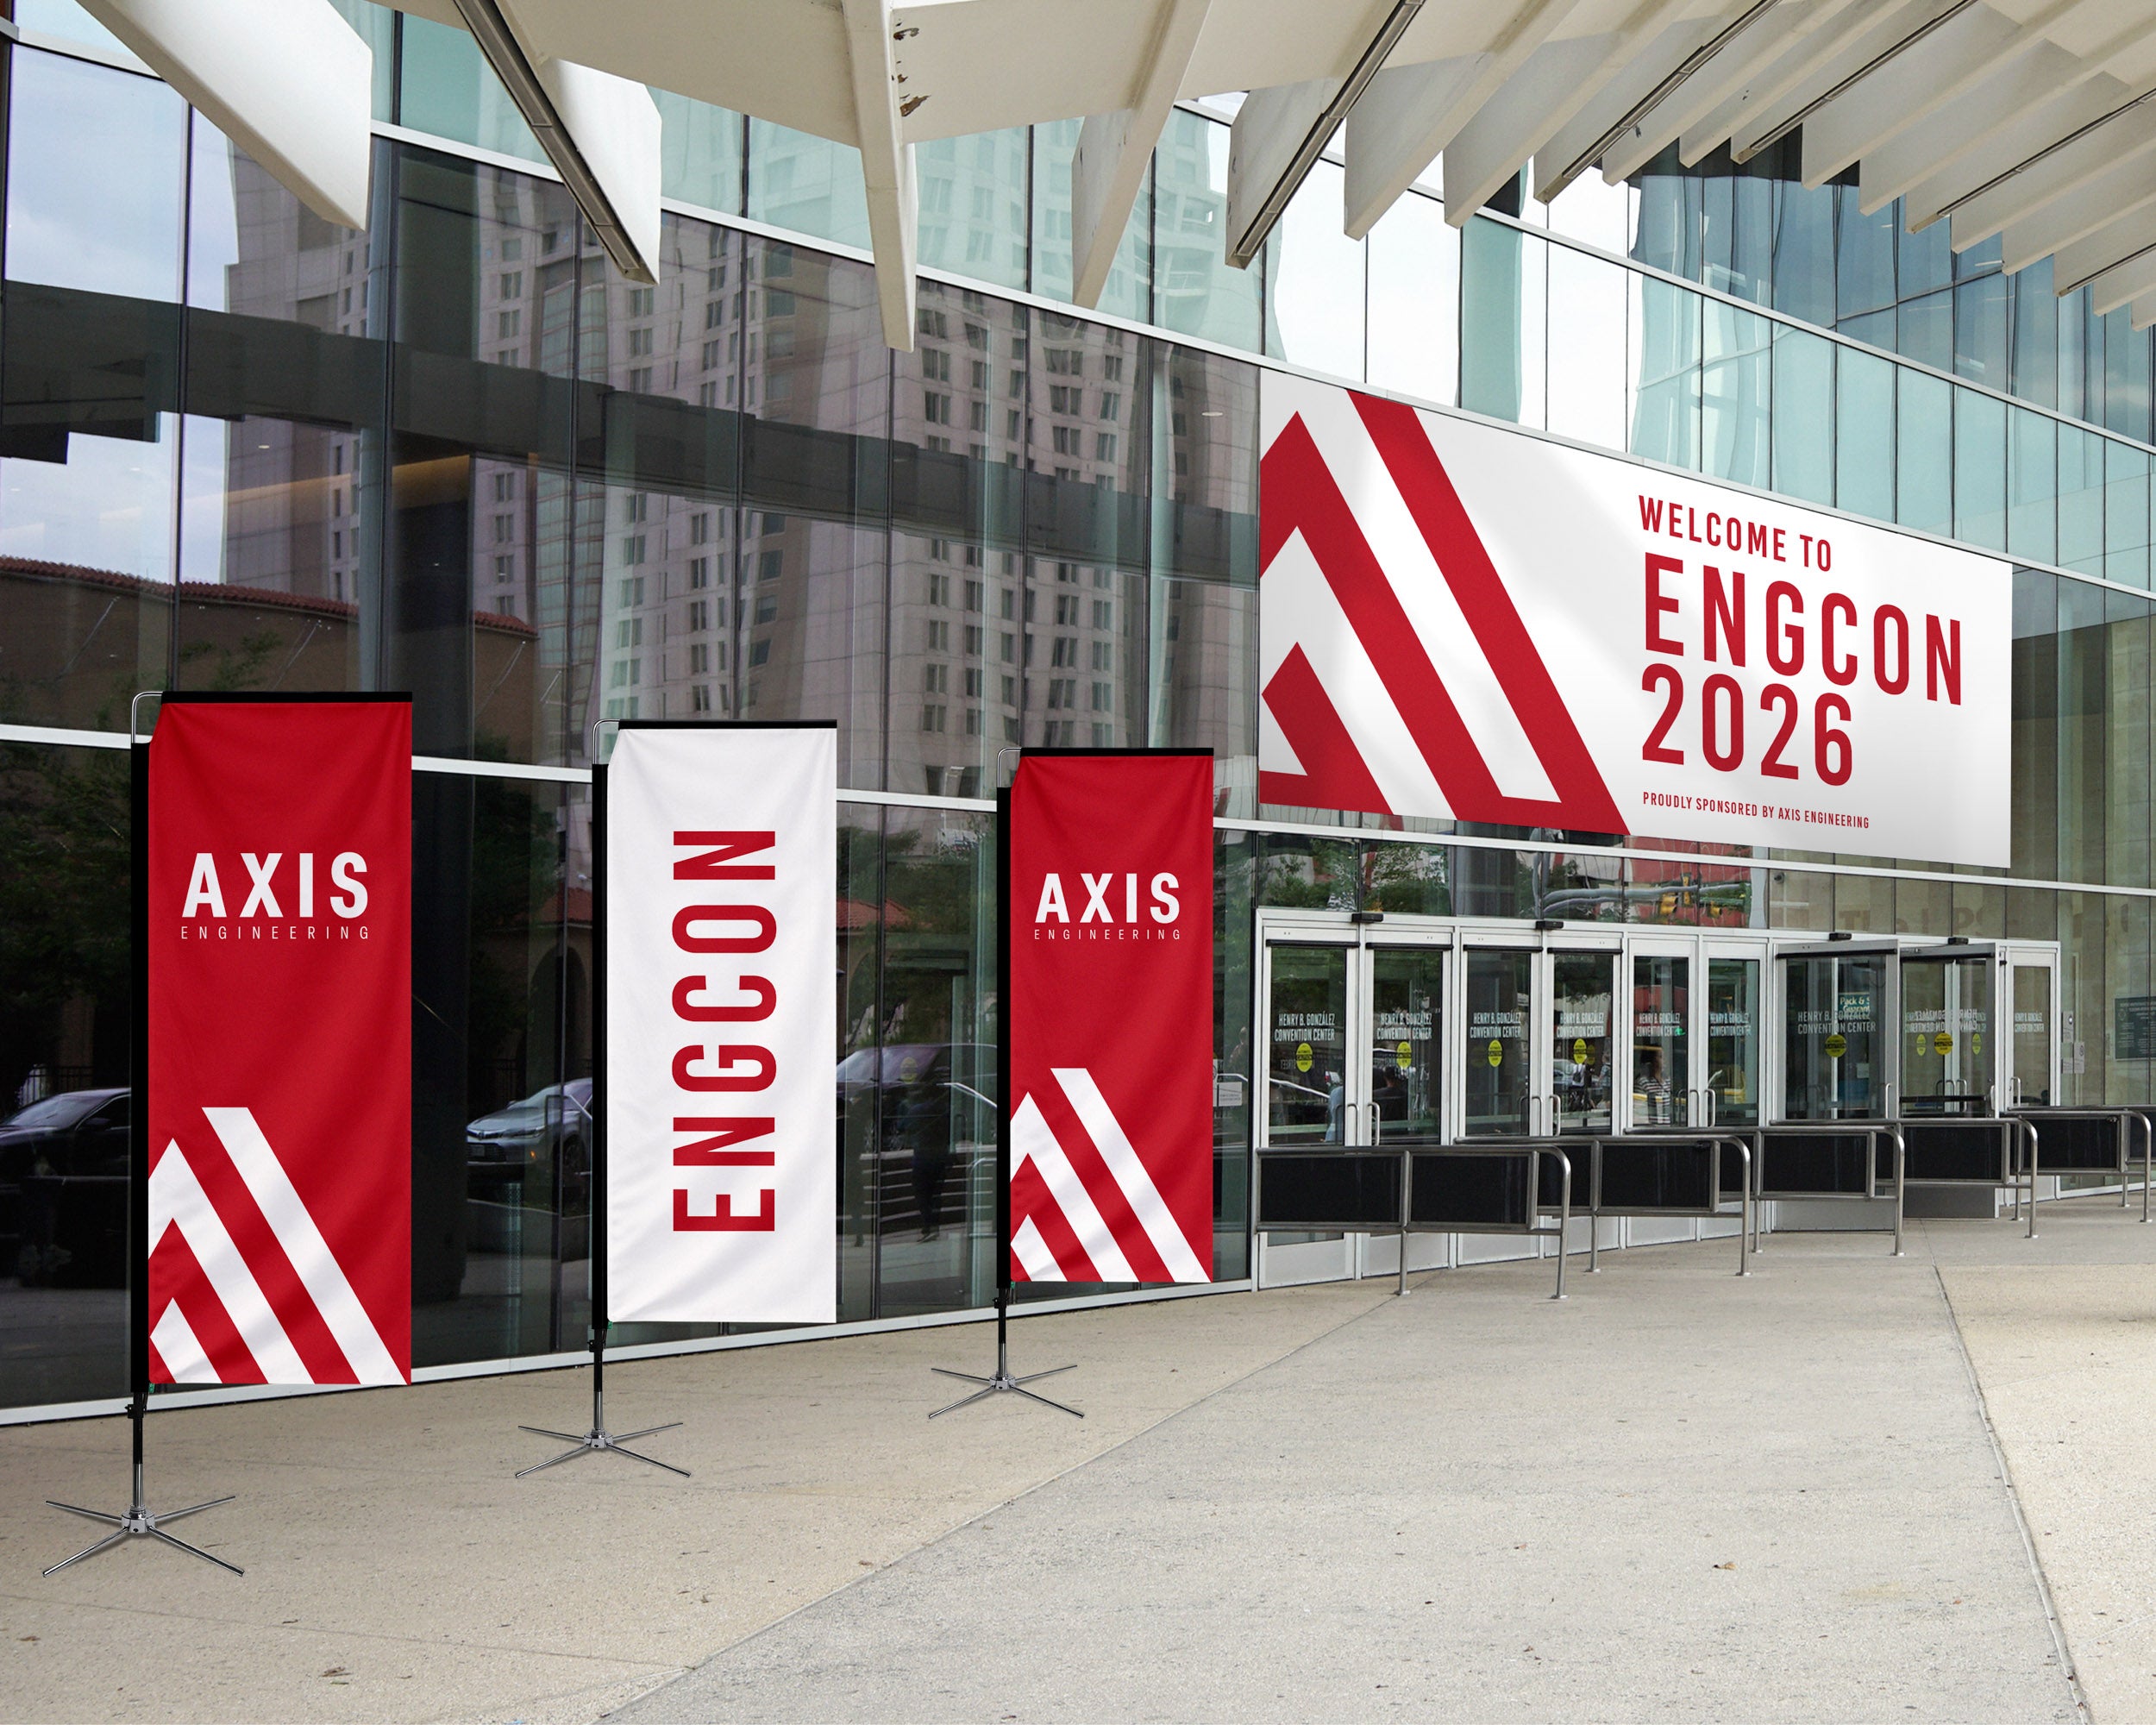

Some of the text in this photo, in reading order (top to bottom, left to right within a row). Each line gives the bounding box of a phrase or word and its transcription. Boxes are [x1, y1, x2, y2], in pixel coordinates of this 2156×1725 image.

[1638, 494, 1832, 573] WELCOME TO
[1645, 551, 1962, 706] ENGCON
[1641, 662, 1853, 787] 2026
[1643, 791, 1869, 829] PROUDLY SPONSORED BY AXIS ENGINEERING
[181, 851, 368, 919] AXIS
[1034, 872, 1180, 925] AXIS
[181, 925, 369, 940] ENGINEERING
[1034, 929, 1181, 940] ENGINEERING
[1839, 997, 1858, 1006] Pack
[1858, 996, 1865, 1005] &
[1278, 1013, 1298, 1026] HENRY
[1473, 1012, 1490, 1025] HENRY
[1797, 1011, 1823, 1022] HENRY
[671, 830, 778, 1233] ENGCON
[1470, 1026, 1521, 1038] CONVENTION CENTER
[1847, 1021, 1877, 1033] CENTER
[1275, 1028, 1335, 1042] CONVENTION CENTER
